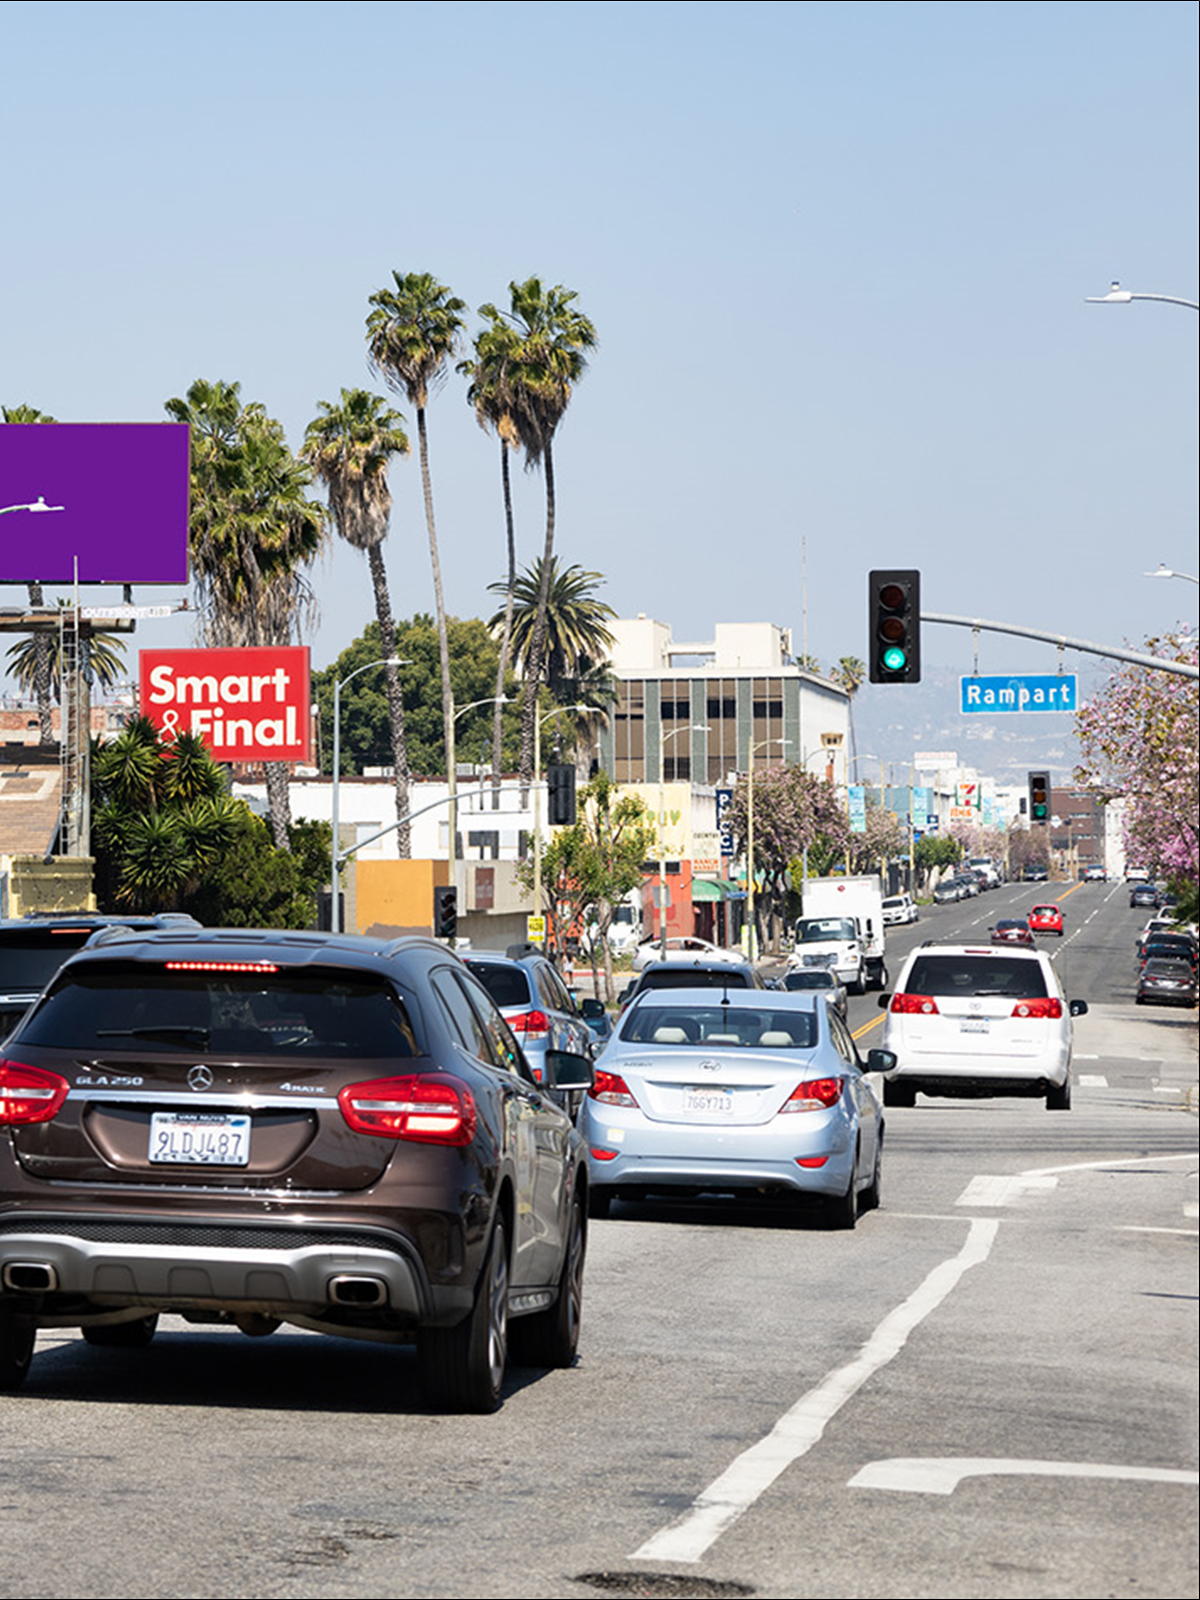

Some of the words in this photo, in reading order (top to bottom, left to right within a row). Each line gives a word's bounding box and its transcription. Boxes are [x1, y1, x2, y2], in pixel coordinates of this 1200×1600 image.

[149, 665, 290, 704] Smart
[967, 683, 1070, 711] Rampart
[75, 1076, 109, 1086] GLA
[110, 1076, 144, 1086] 250
[158, 1131, 243, 1156] 9LDJ487
